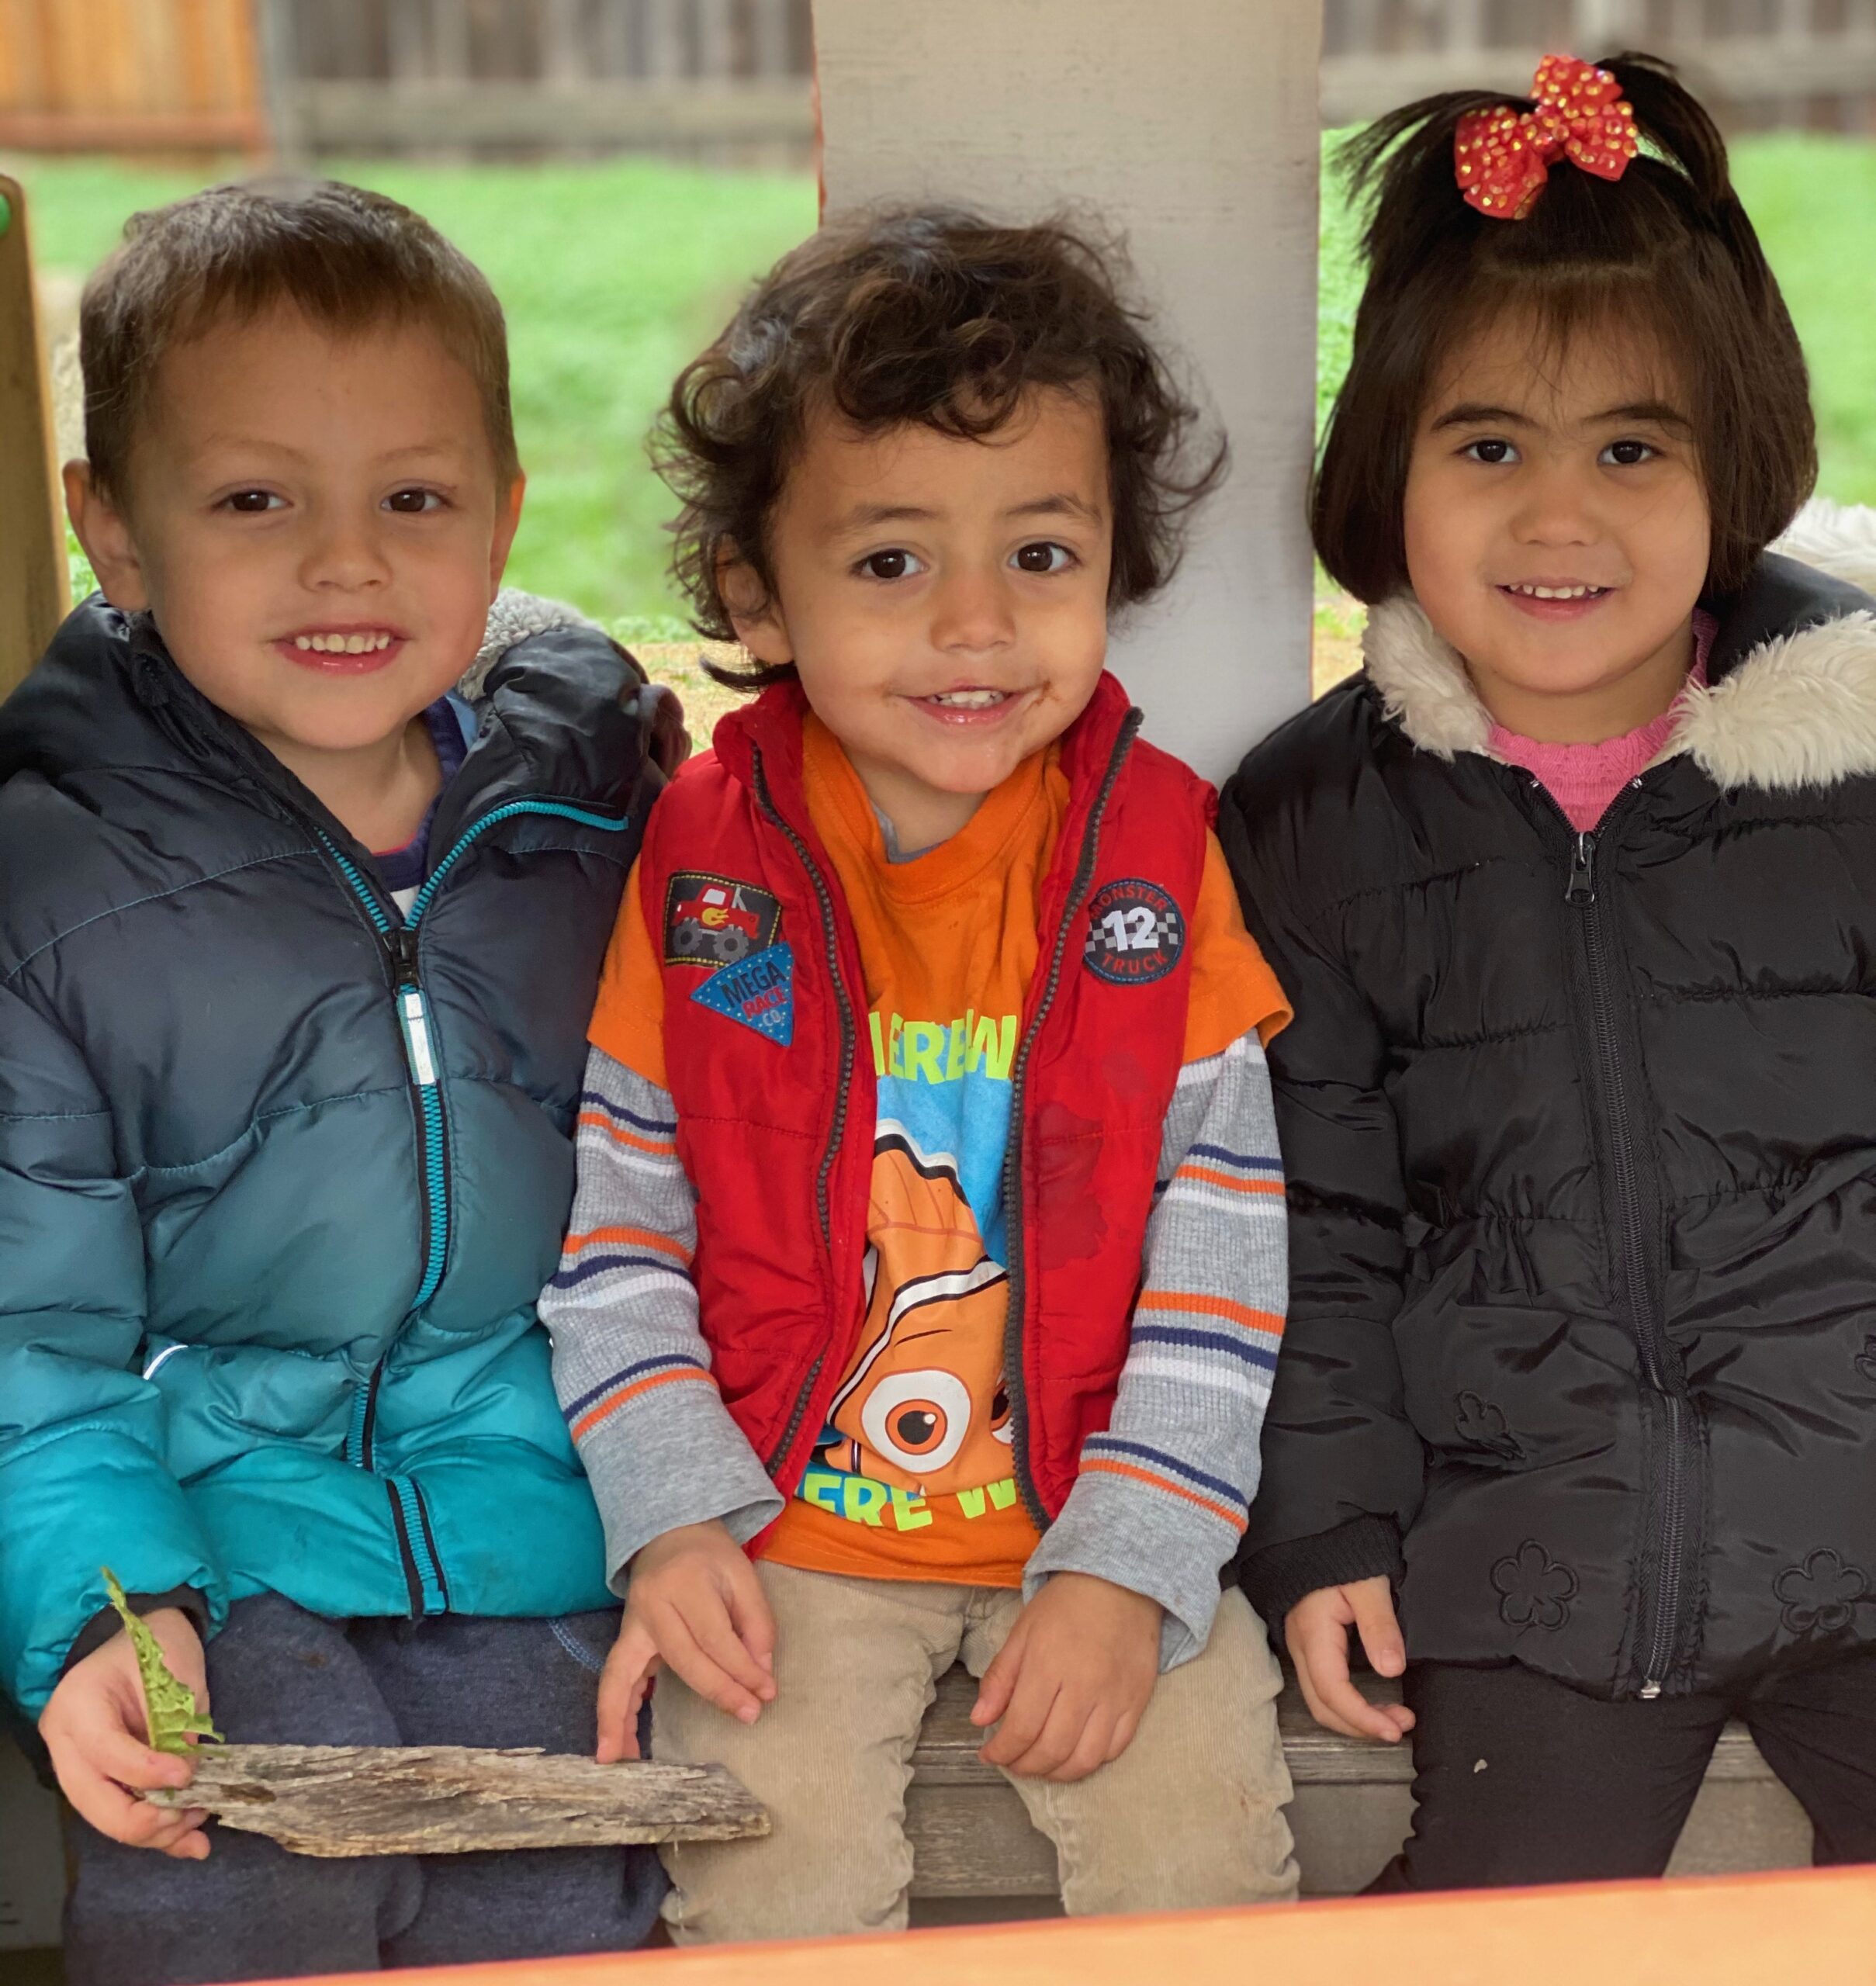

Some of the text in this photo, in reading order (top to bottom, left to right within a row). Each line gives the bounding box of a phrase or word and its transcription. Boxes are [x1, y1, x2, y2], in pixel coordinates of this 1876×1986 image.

[1090, 884, 1168, 919] MONSTER
[1102, 906, 1159, 952] 12
[1102, 950, 1168, 974] TRUCK
[720, 960, 787, 1009] MEGA
[742, 984, 788, 1021] RACE
